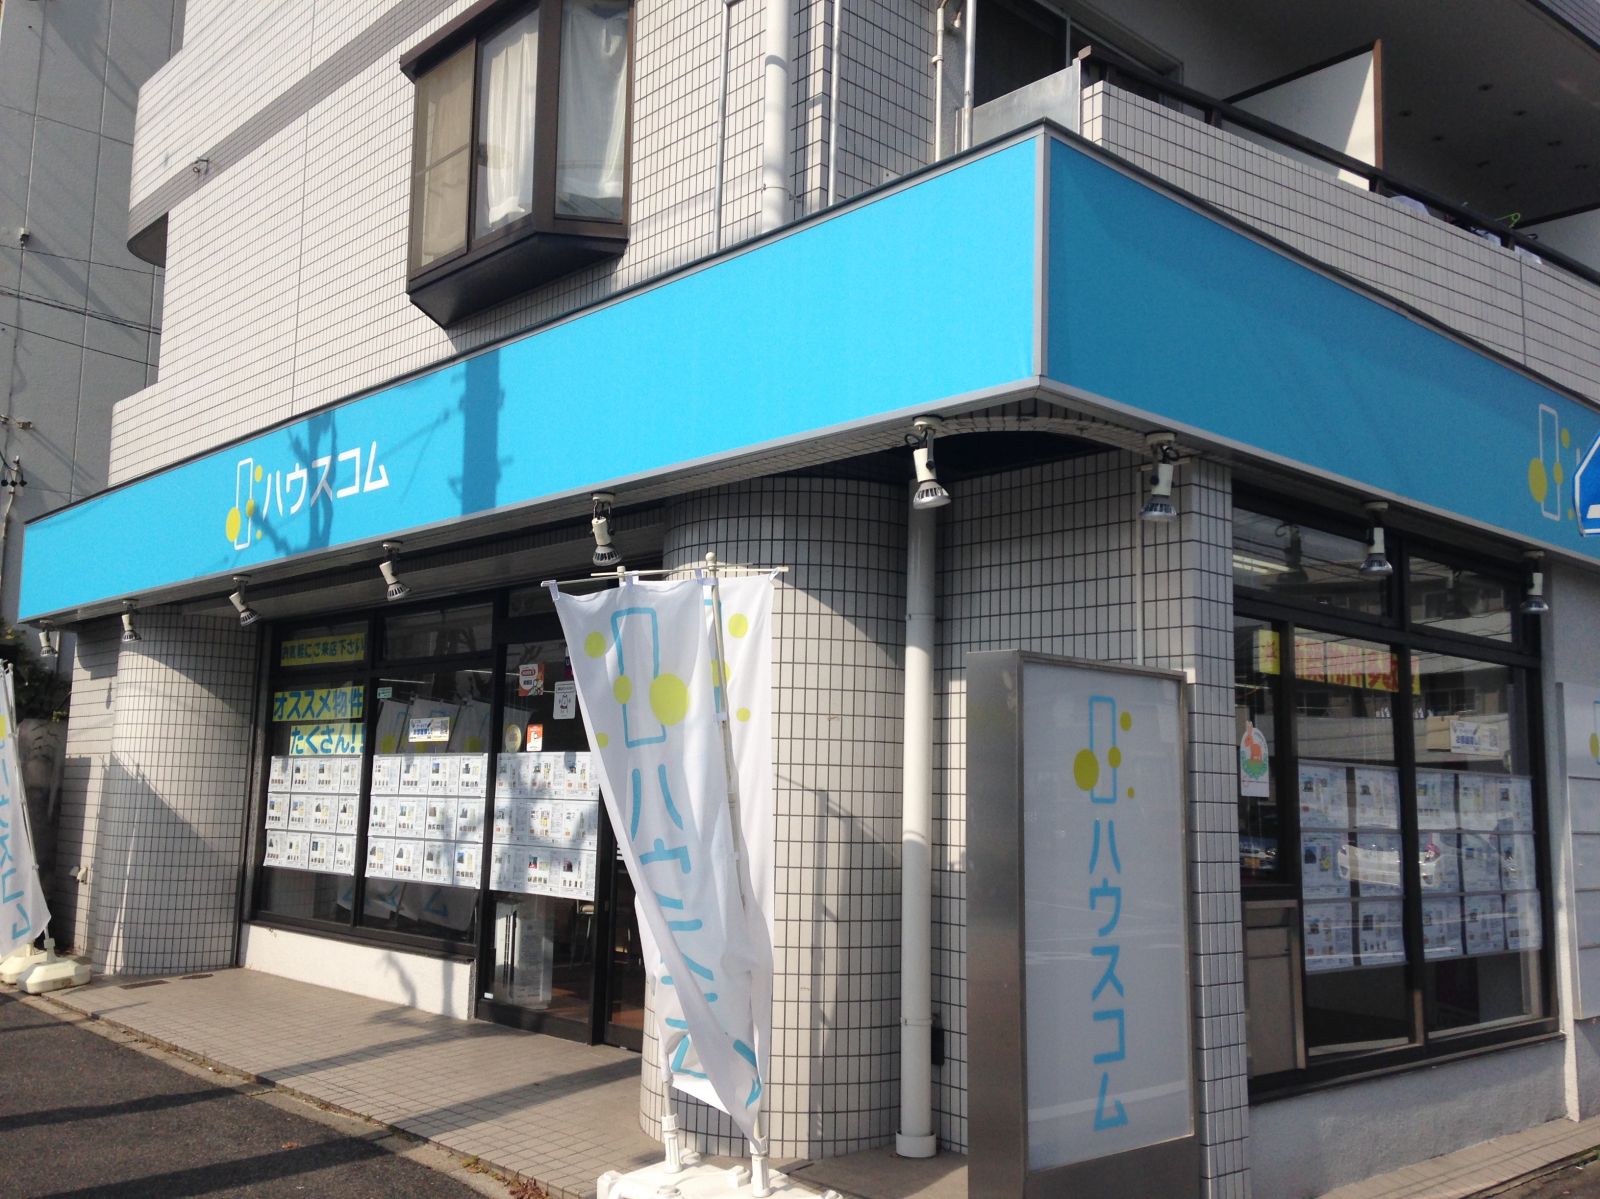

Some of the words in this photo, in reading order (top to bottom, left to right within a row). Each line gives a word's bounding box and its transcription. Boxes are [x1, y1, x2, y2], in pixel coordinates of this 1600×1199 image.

[262, 440, 390, 521] ハウスコム
[273, 686, 364, 720] オススメ物件
[1088, 819, 1129, 1132] ハウスコム
